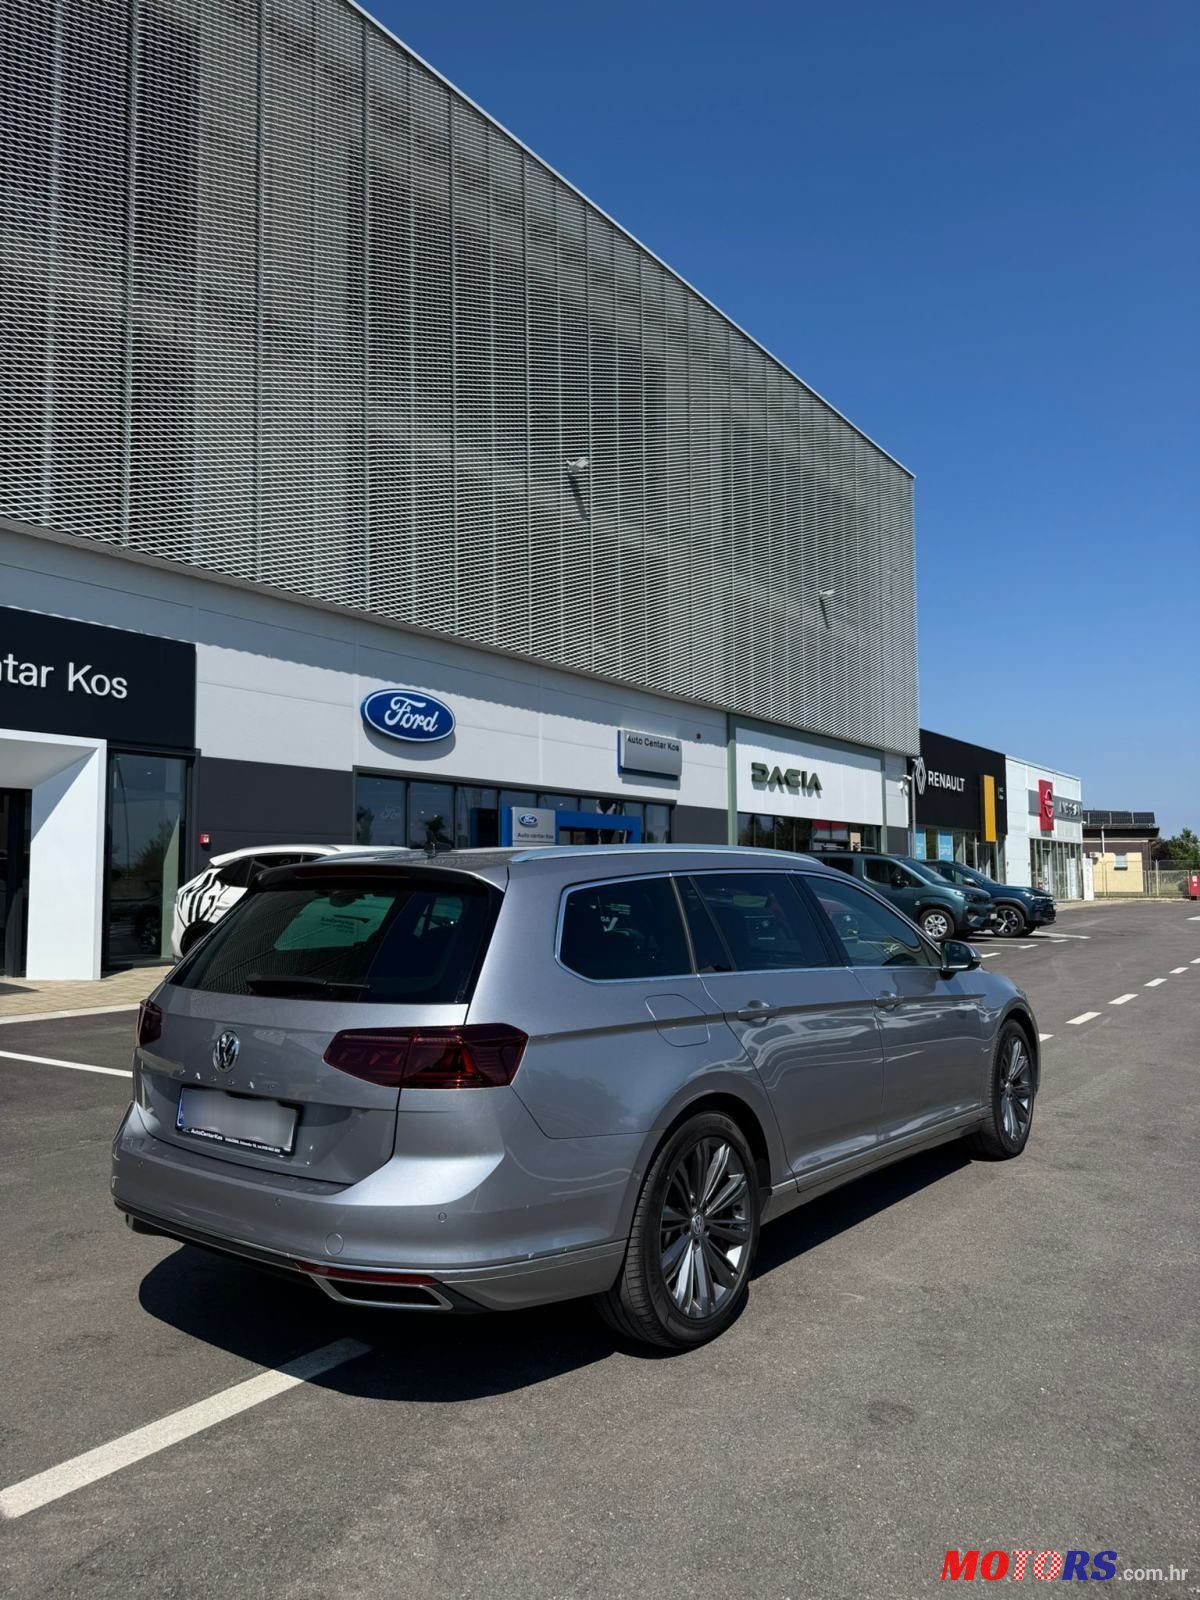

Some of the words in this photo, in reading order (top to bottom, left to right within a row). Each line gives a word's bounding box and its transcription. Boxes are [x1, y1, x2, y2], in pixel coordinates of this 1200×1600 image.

[0, 654, 54, 688] tar
[68, 662, 128, 699] Kos
[384, 696, 439, 732] Ford
[627, 735, 643, 745] Auto
[751, 762, 823, 790] DACIA
[928, 771, 965, 792] RENAULT
